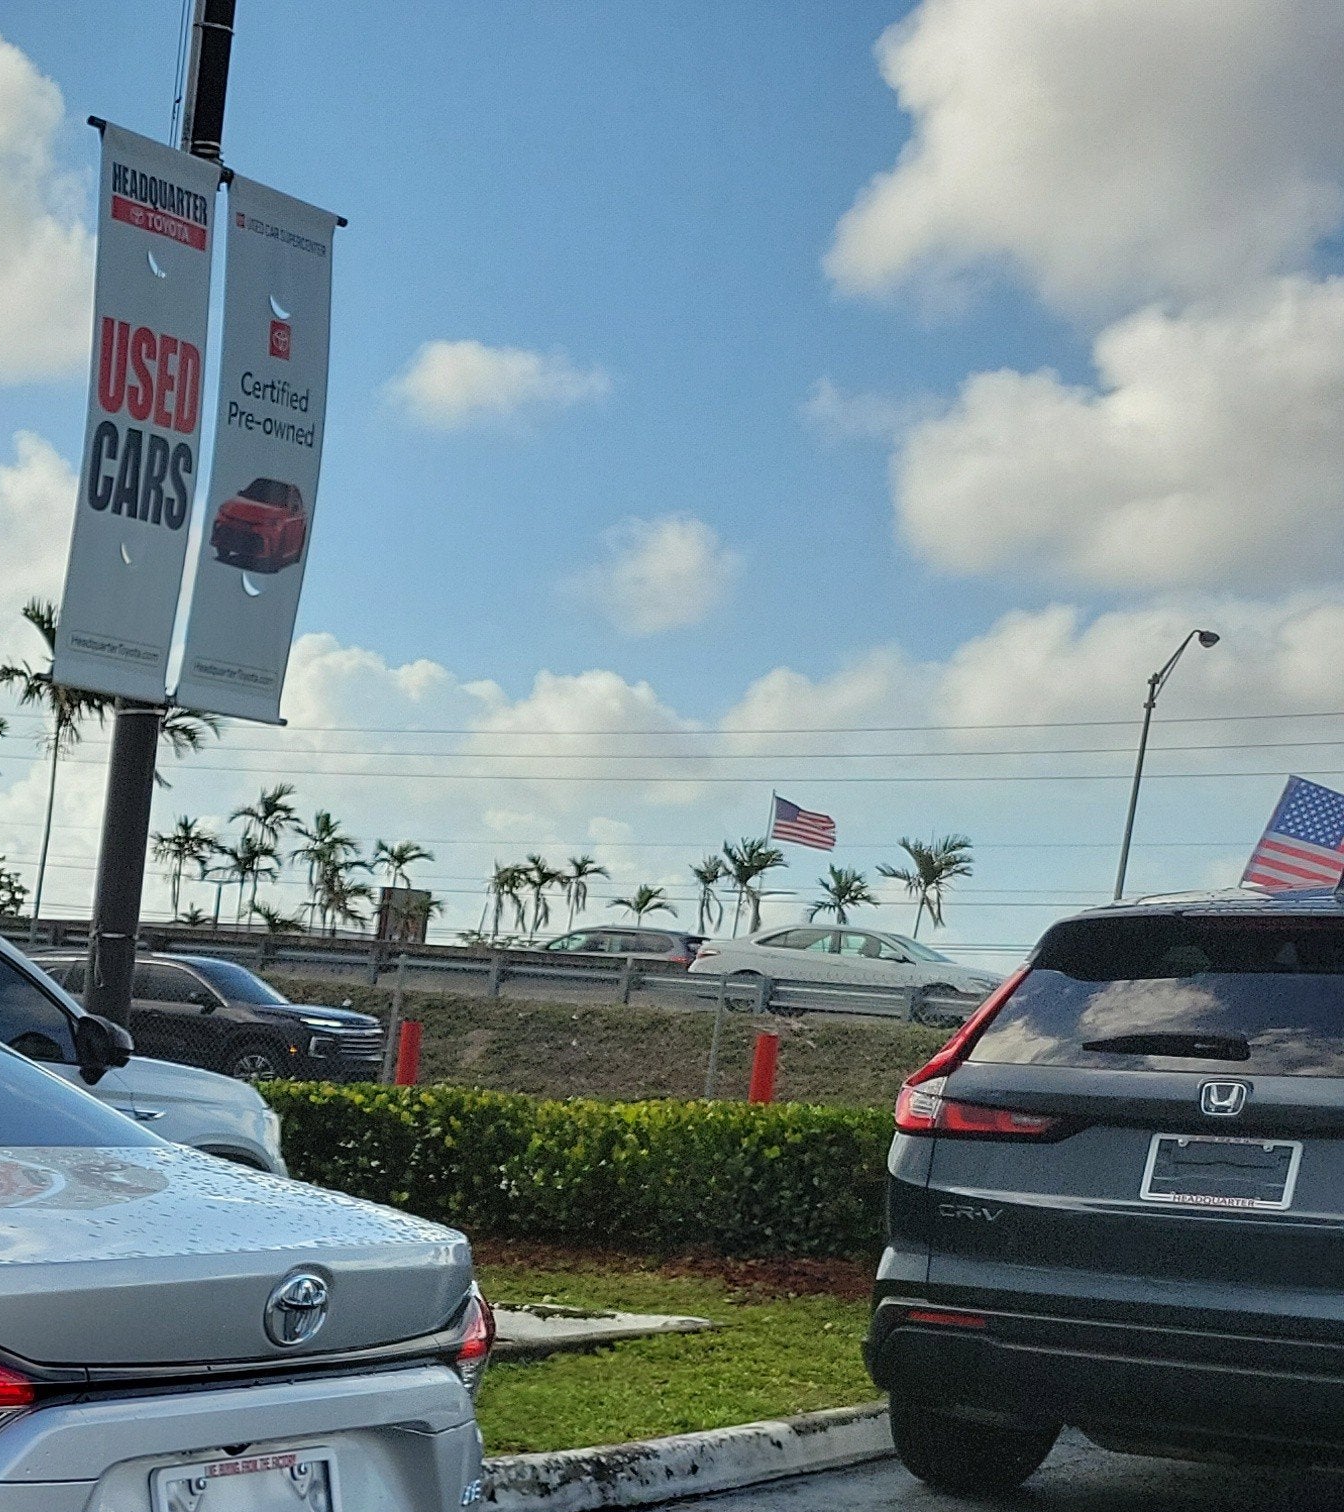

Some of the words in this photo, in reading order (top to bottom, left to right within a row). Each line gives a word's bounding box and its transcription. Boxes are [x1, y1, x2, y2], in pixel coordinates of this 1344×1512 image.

[112, 161, 208, 226] HEADQUARTER
[147, 213, 189, 241] TOYOTA
[98, 317, 201, 434] USED
[241, 371, 309, 412] Certified
[228, 401, 315, 447] Pre-owned
[88, 420, 192, 530] CARS
[939, 1203, 1003, 1221] CR-V
[1172, 1193, 1256, 1207] HEADQUARTER
